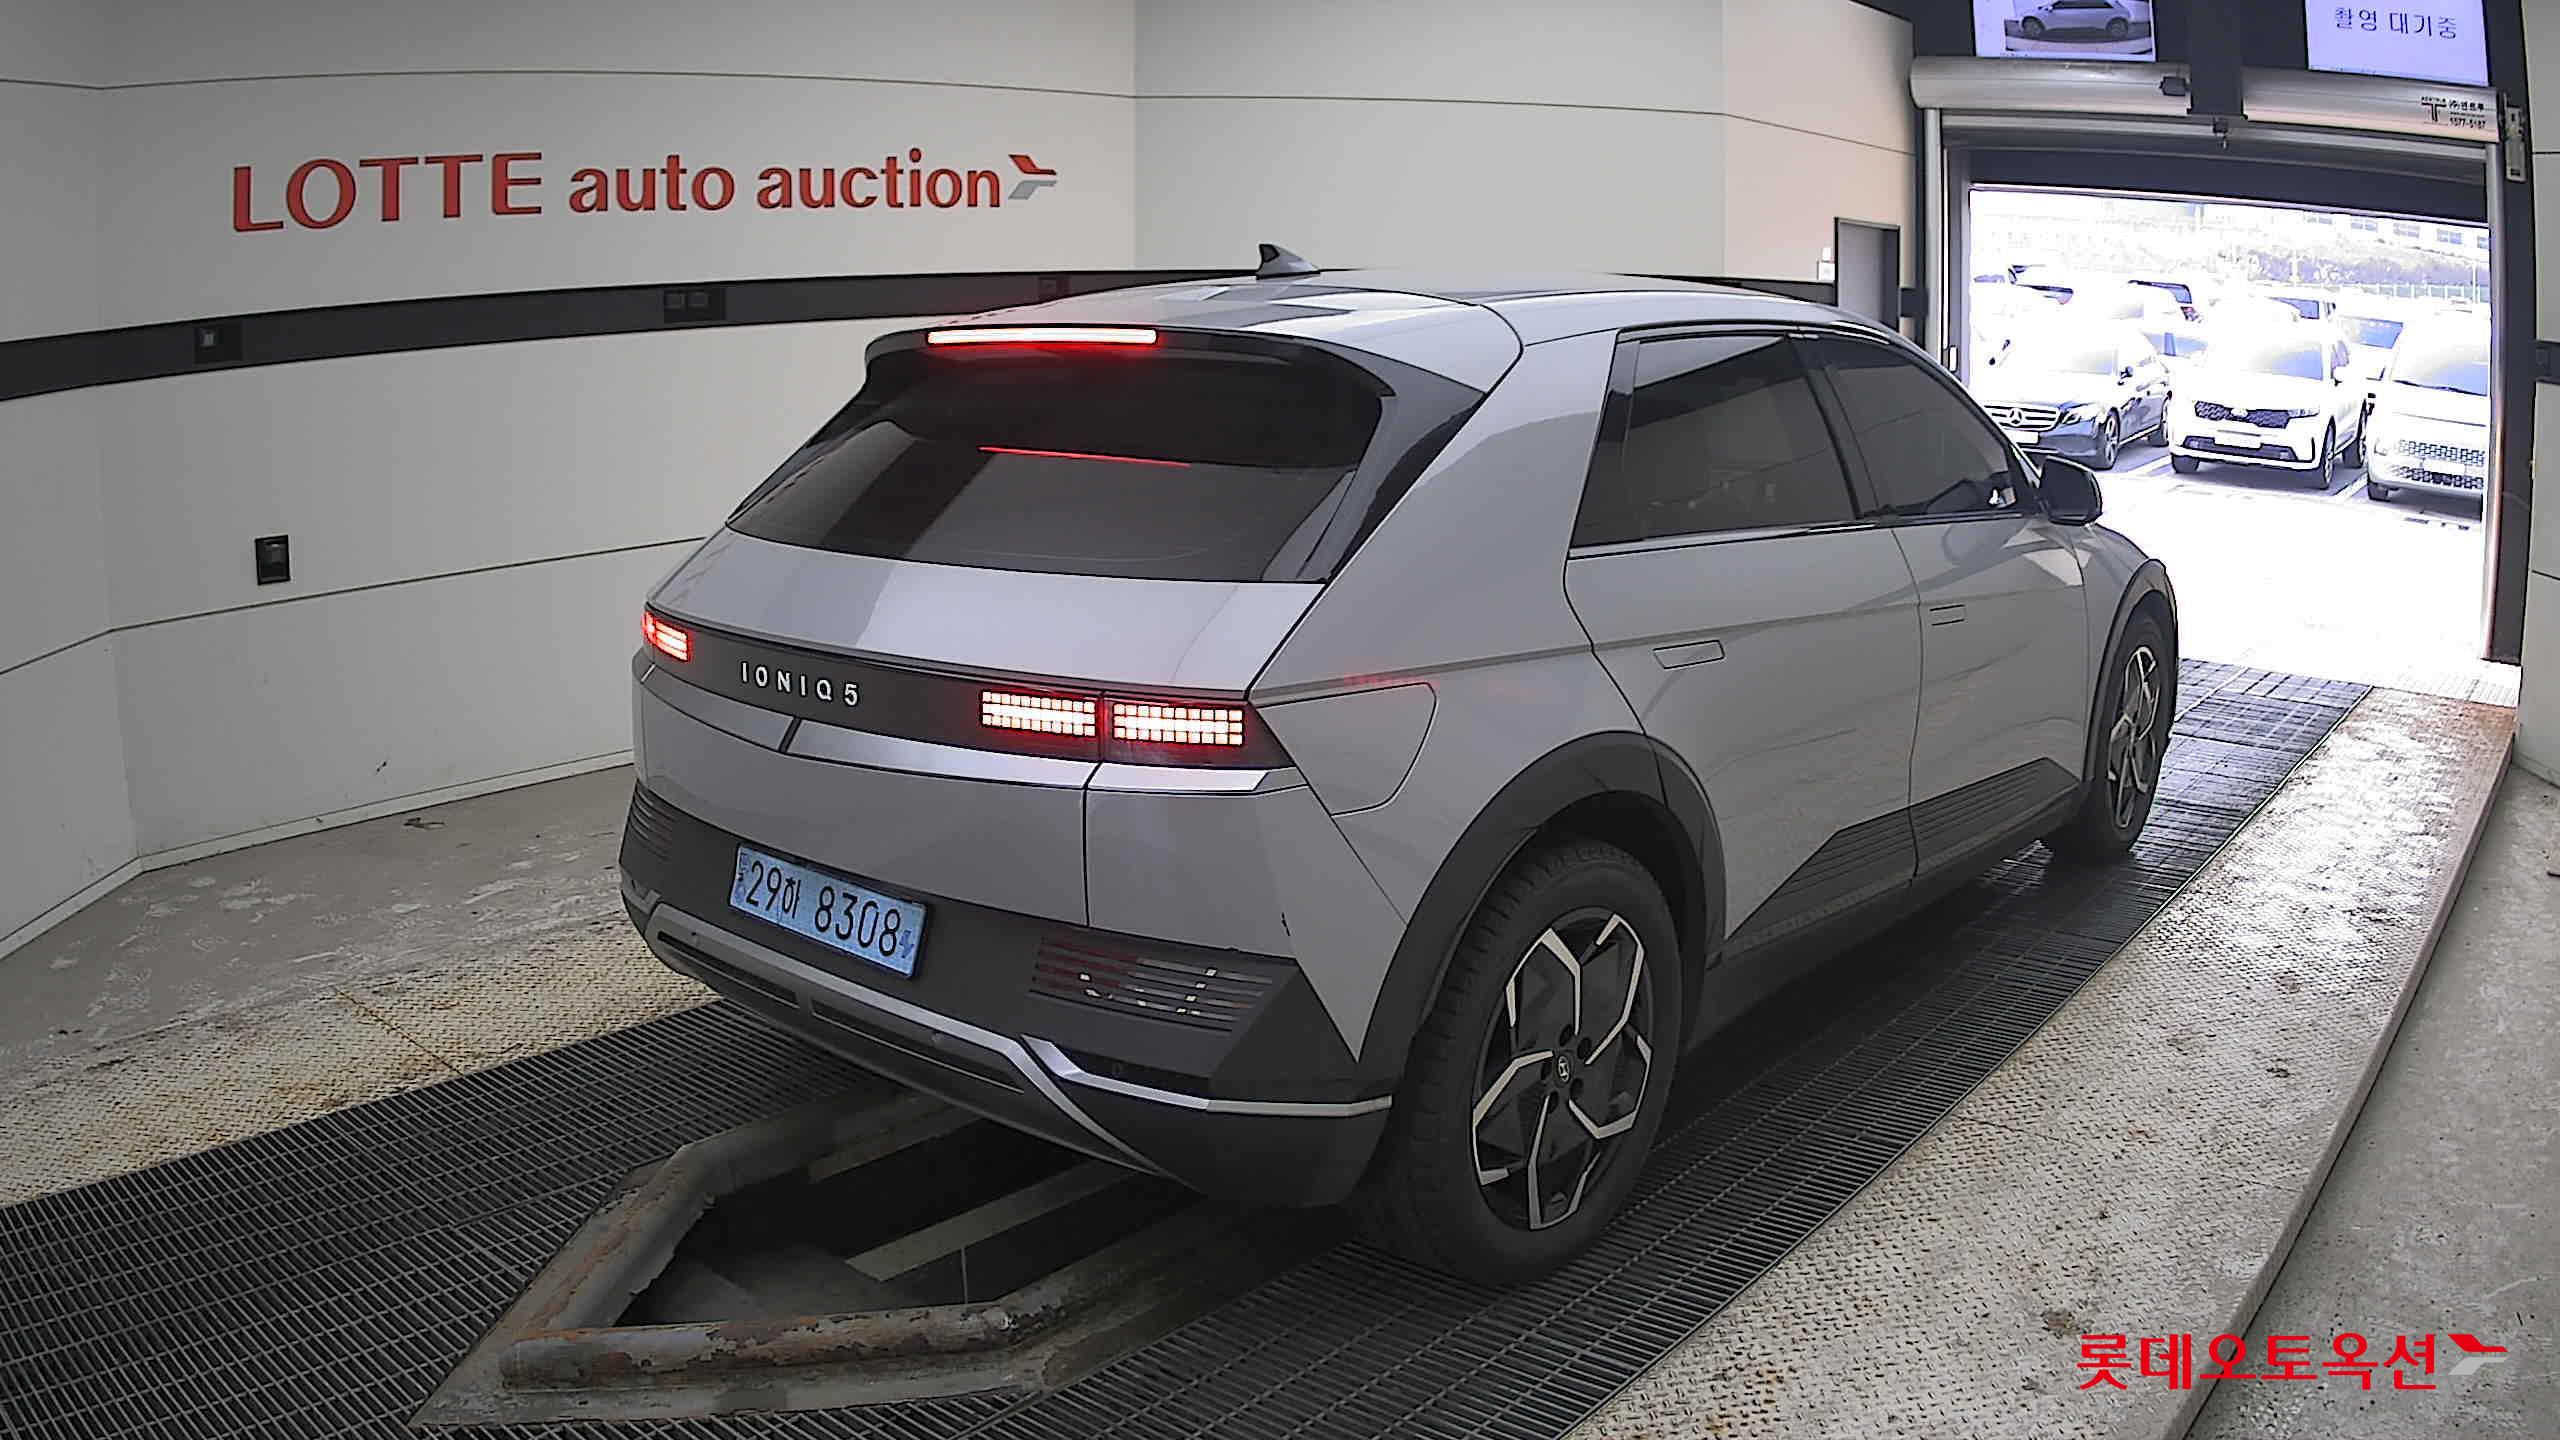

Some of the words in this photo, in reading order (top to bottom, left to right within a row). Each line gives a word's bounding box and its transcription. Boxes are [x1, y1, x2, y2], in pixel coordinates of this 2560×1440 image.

[2335, 7, 2378, 32] 촬영
[2388, 11, 2457, 40] 대기중
[233, 151, 542, 232] LOTTE
[568, 153, 737, 213] auto
[757, 147, 1002, 209] auction
[741, 661, 833, 702] IONIQ
[844, 682, 859, 706] 5
[745, 860, 801, 920] 29하
[814, 885, 902, 957] 8308
